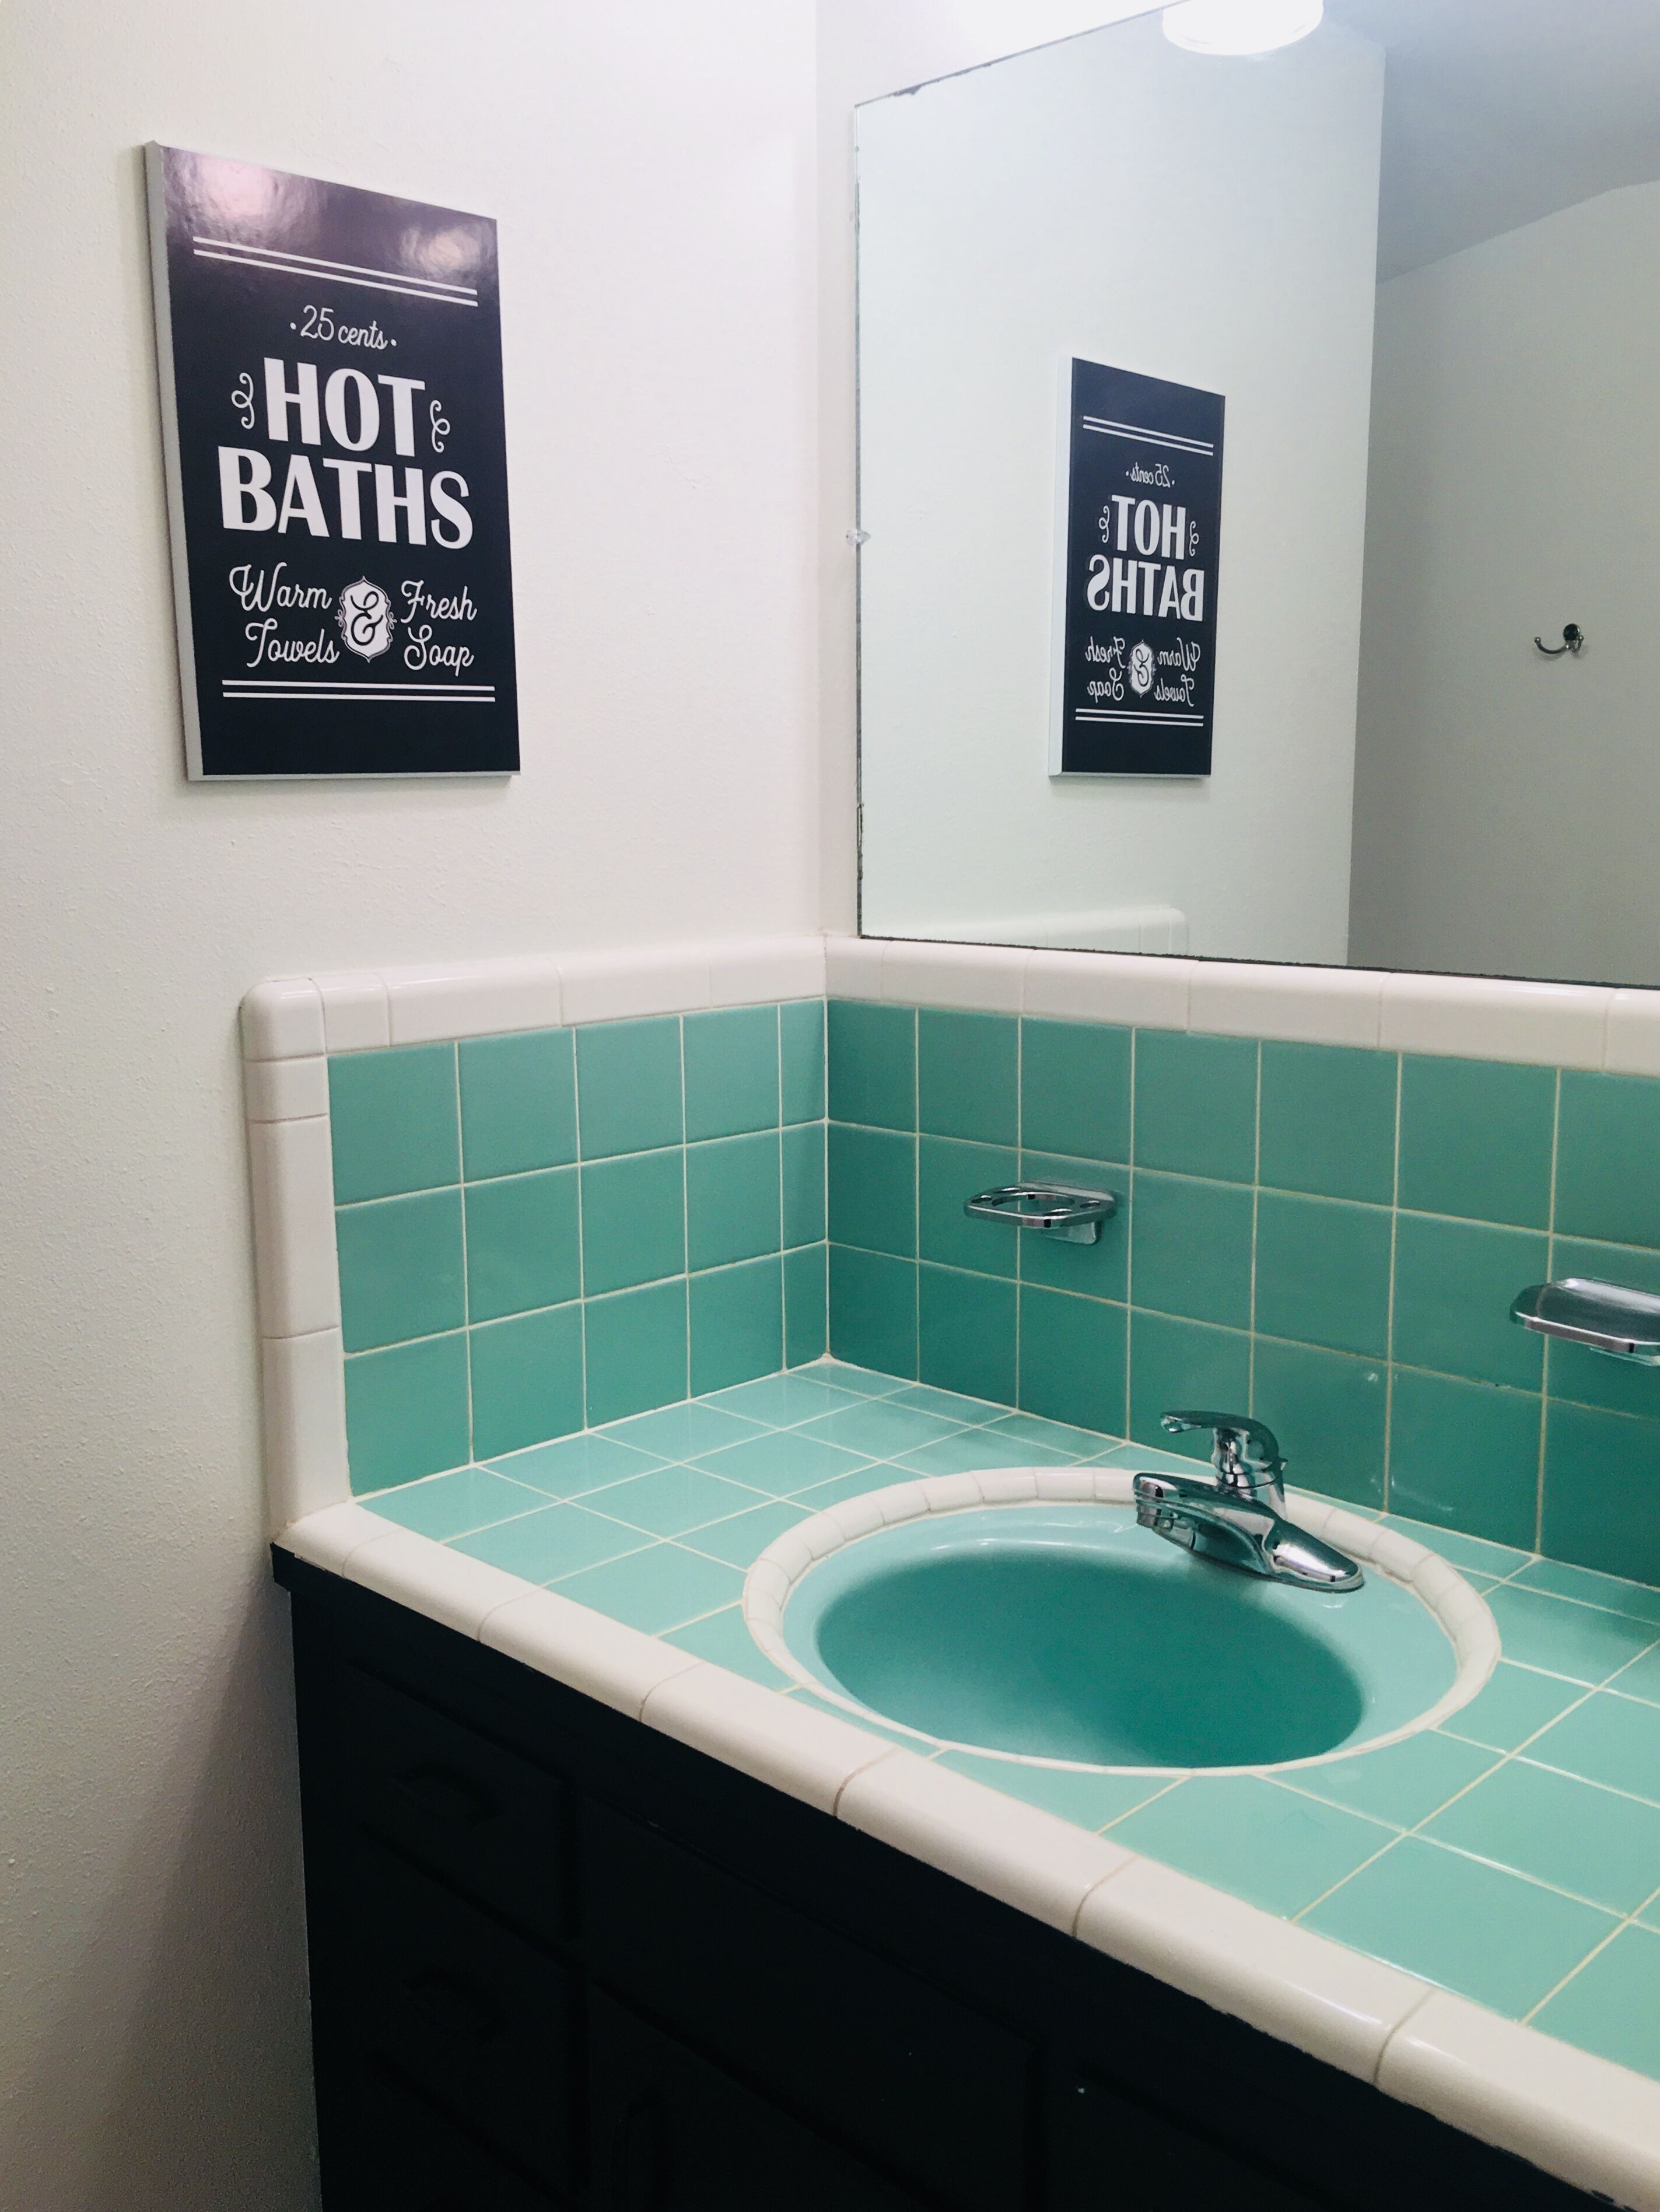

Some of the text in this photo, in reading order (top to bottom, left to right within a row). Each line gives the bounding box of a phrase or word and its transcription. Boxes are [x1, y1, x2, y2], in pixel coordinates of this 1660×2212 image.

[300, 304, 388, 350] 25 cents
[264, 357, 425, 457] HOT
[218, 445, 473, 550] BATHS
[229, 562, 332, 612] Warm
[400, 579, 477, 624] Fresh
[245, 618, 340, 667] Towels
[350, 590, 383, 646] &
[404, 624, 474, 677] Soap
